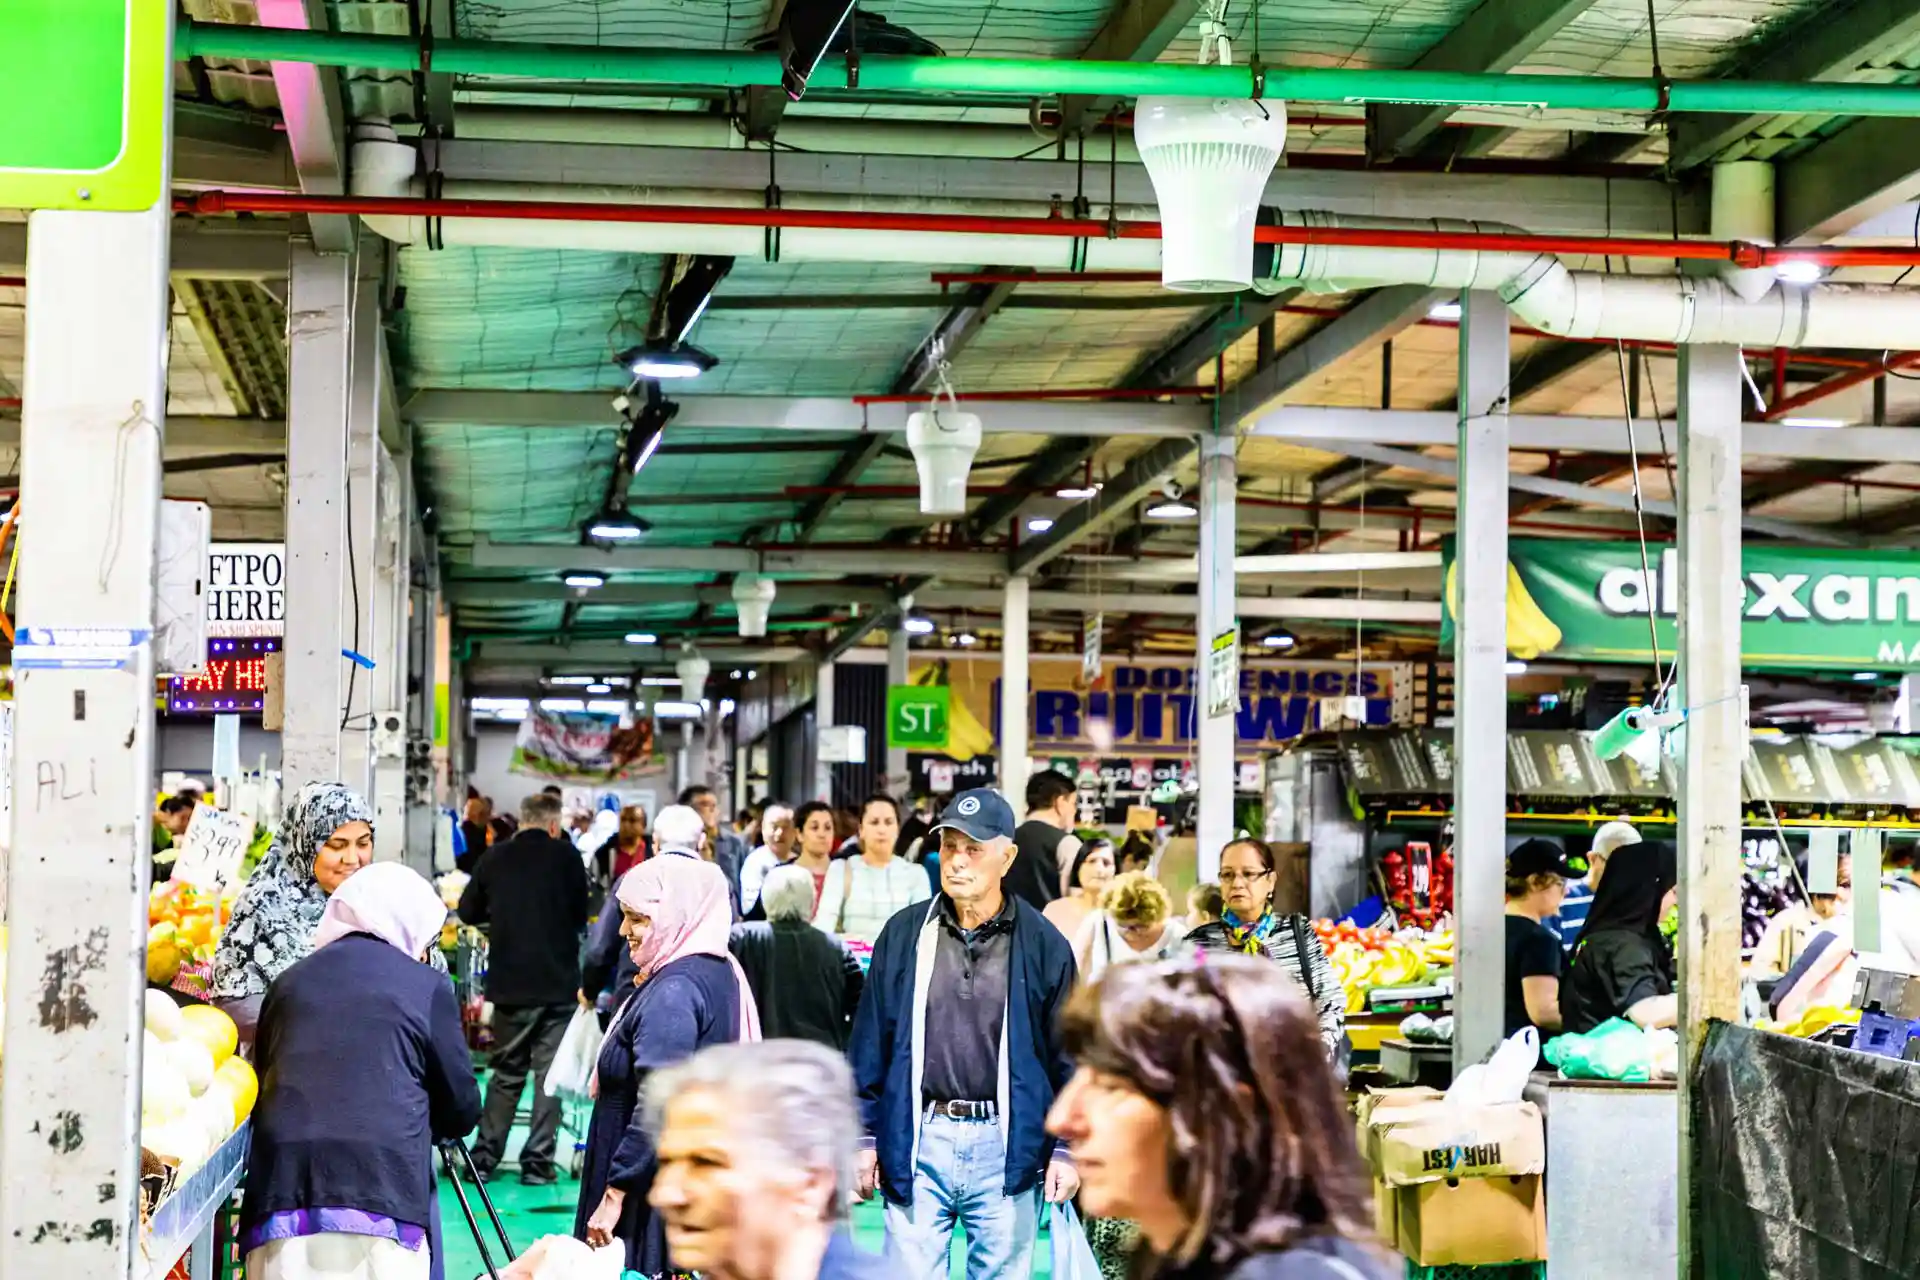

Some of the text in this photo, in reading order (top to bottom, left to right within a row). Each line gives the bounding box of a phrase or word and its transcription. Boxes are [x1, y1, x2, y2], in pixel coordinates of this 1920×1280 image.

[1598, 547, 1920, 621] alxan
[207, 590, 284, 621] HERE
[1113, 666, 1379, 695] DOENICS
[900, 702, 938, 733] ST
